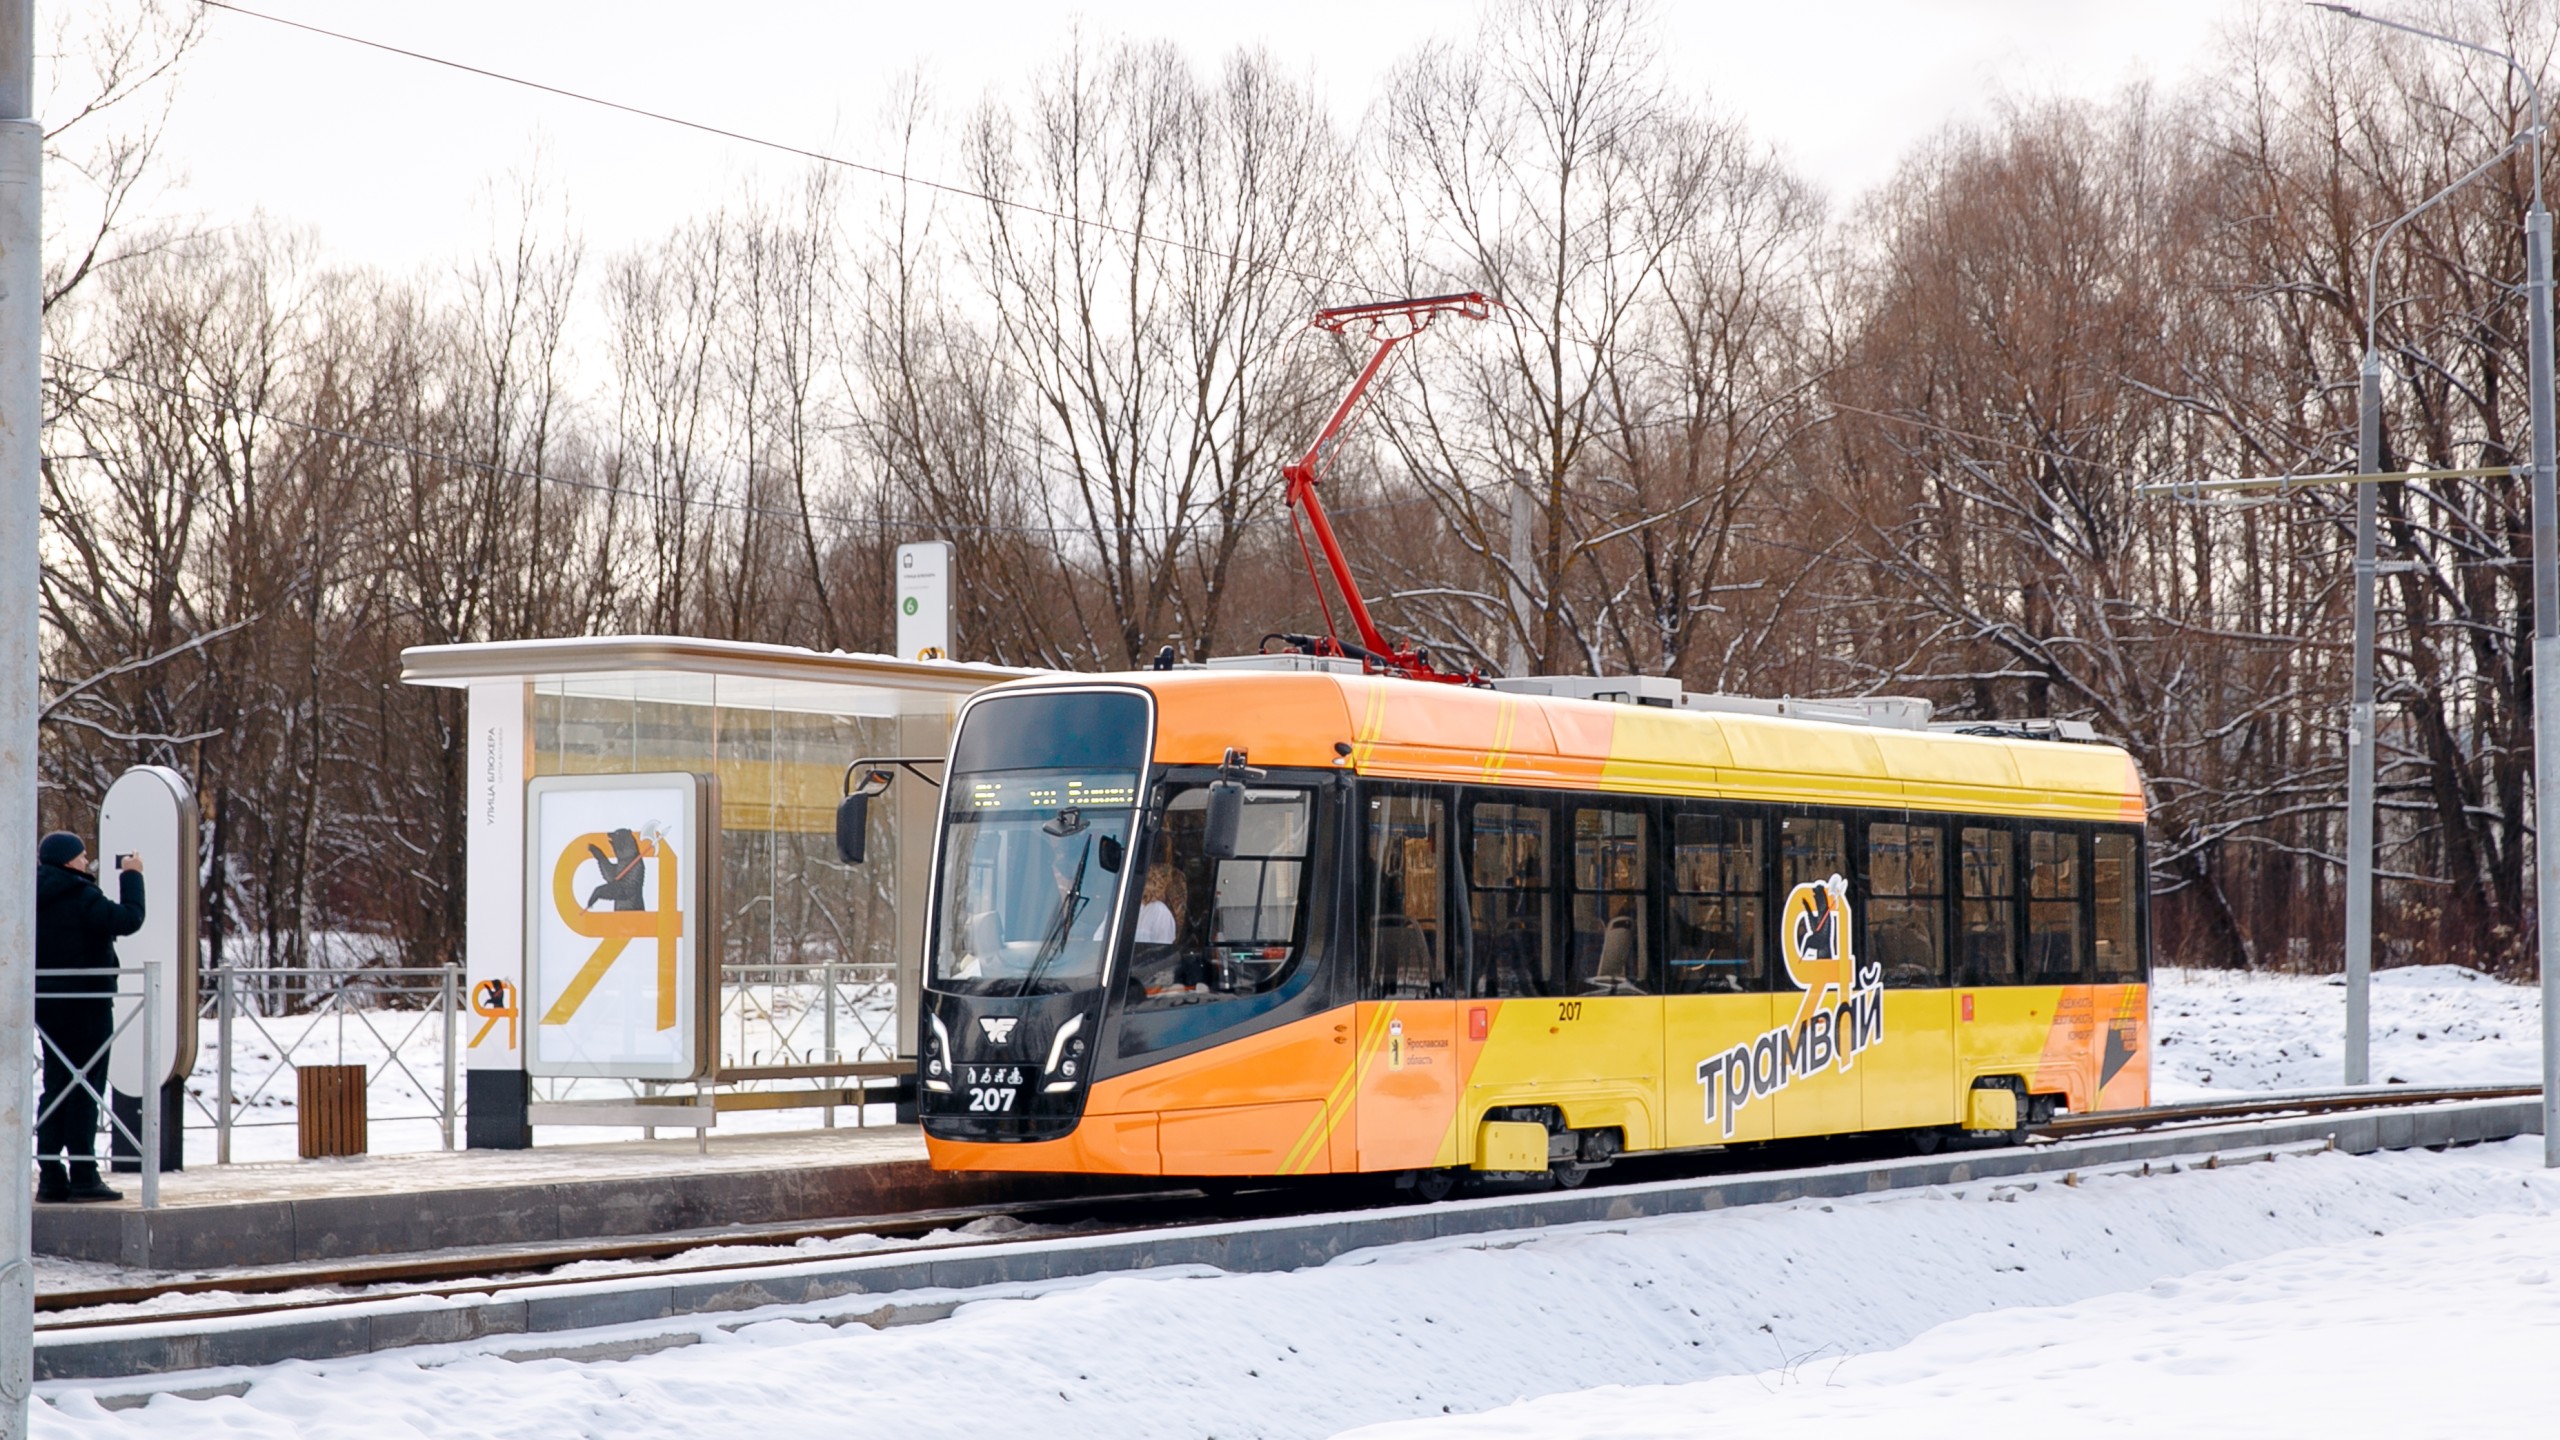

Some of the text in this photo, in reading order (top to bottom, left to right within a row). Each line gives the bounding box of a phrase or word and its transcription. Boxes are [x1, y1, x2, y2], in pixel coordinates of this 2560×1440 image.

[487, 727, 495, 825] УЛИЦА БЛЮХЕРА
[1559, 1002, 1582, 1021] 207
[969, 1088, 1016, 1112] 207
